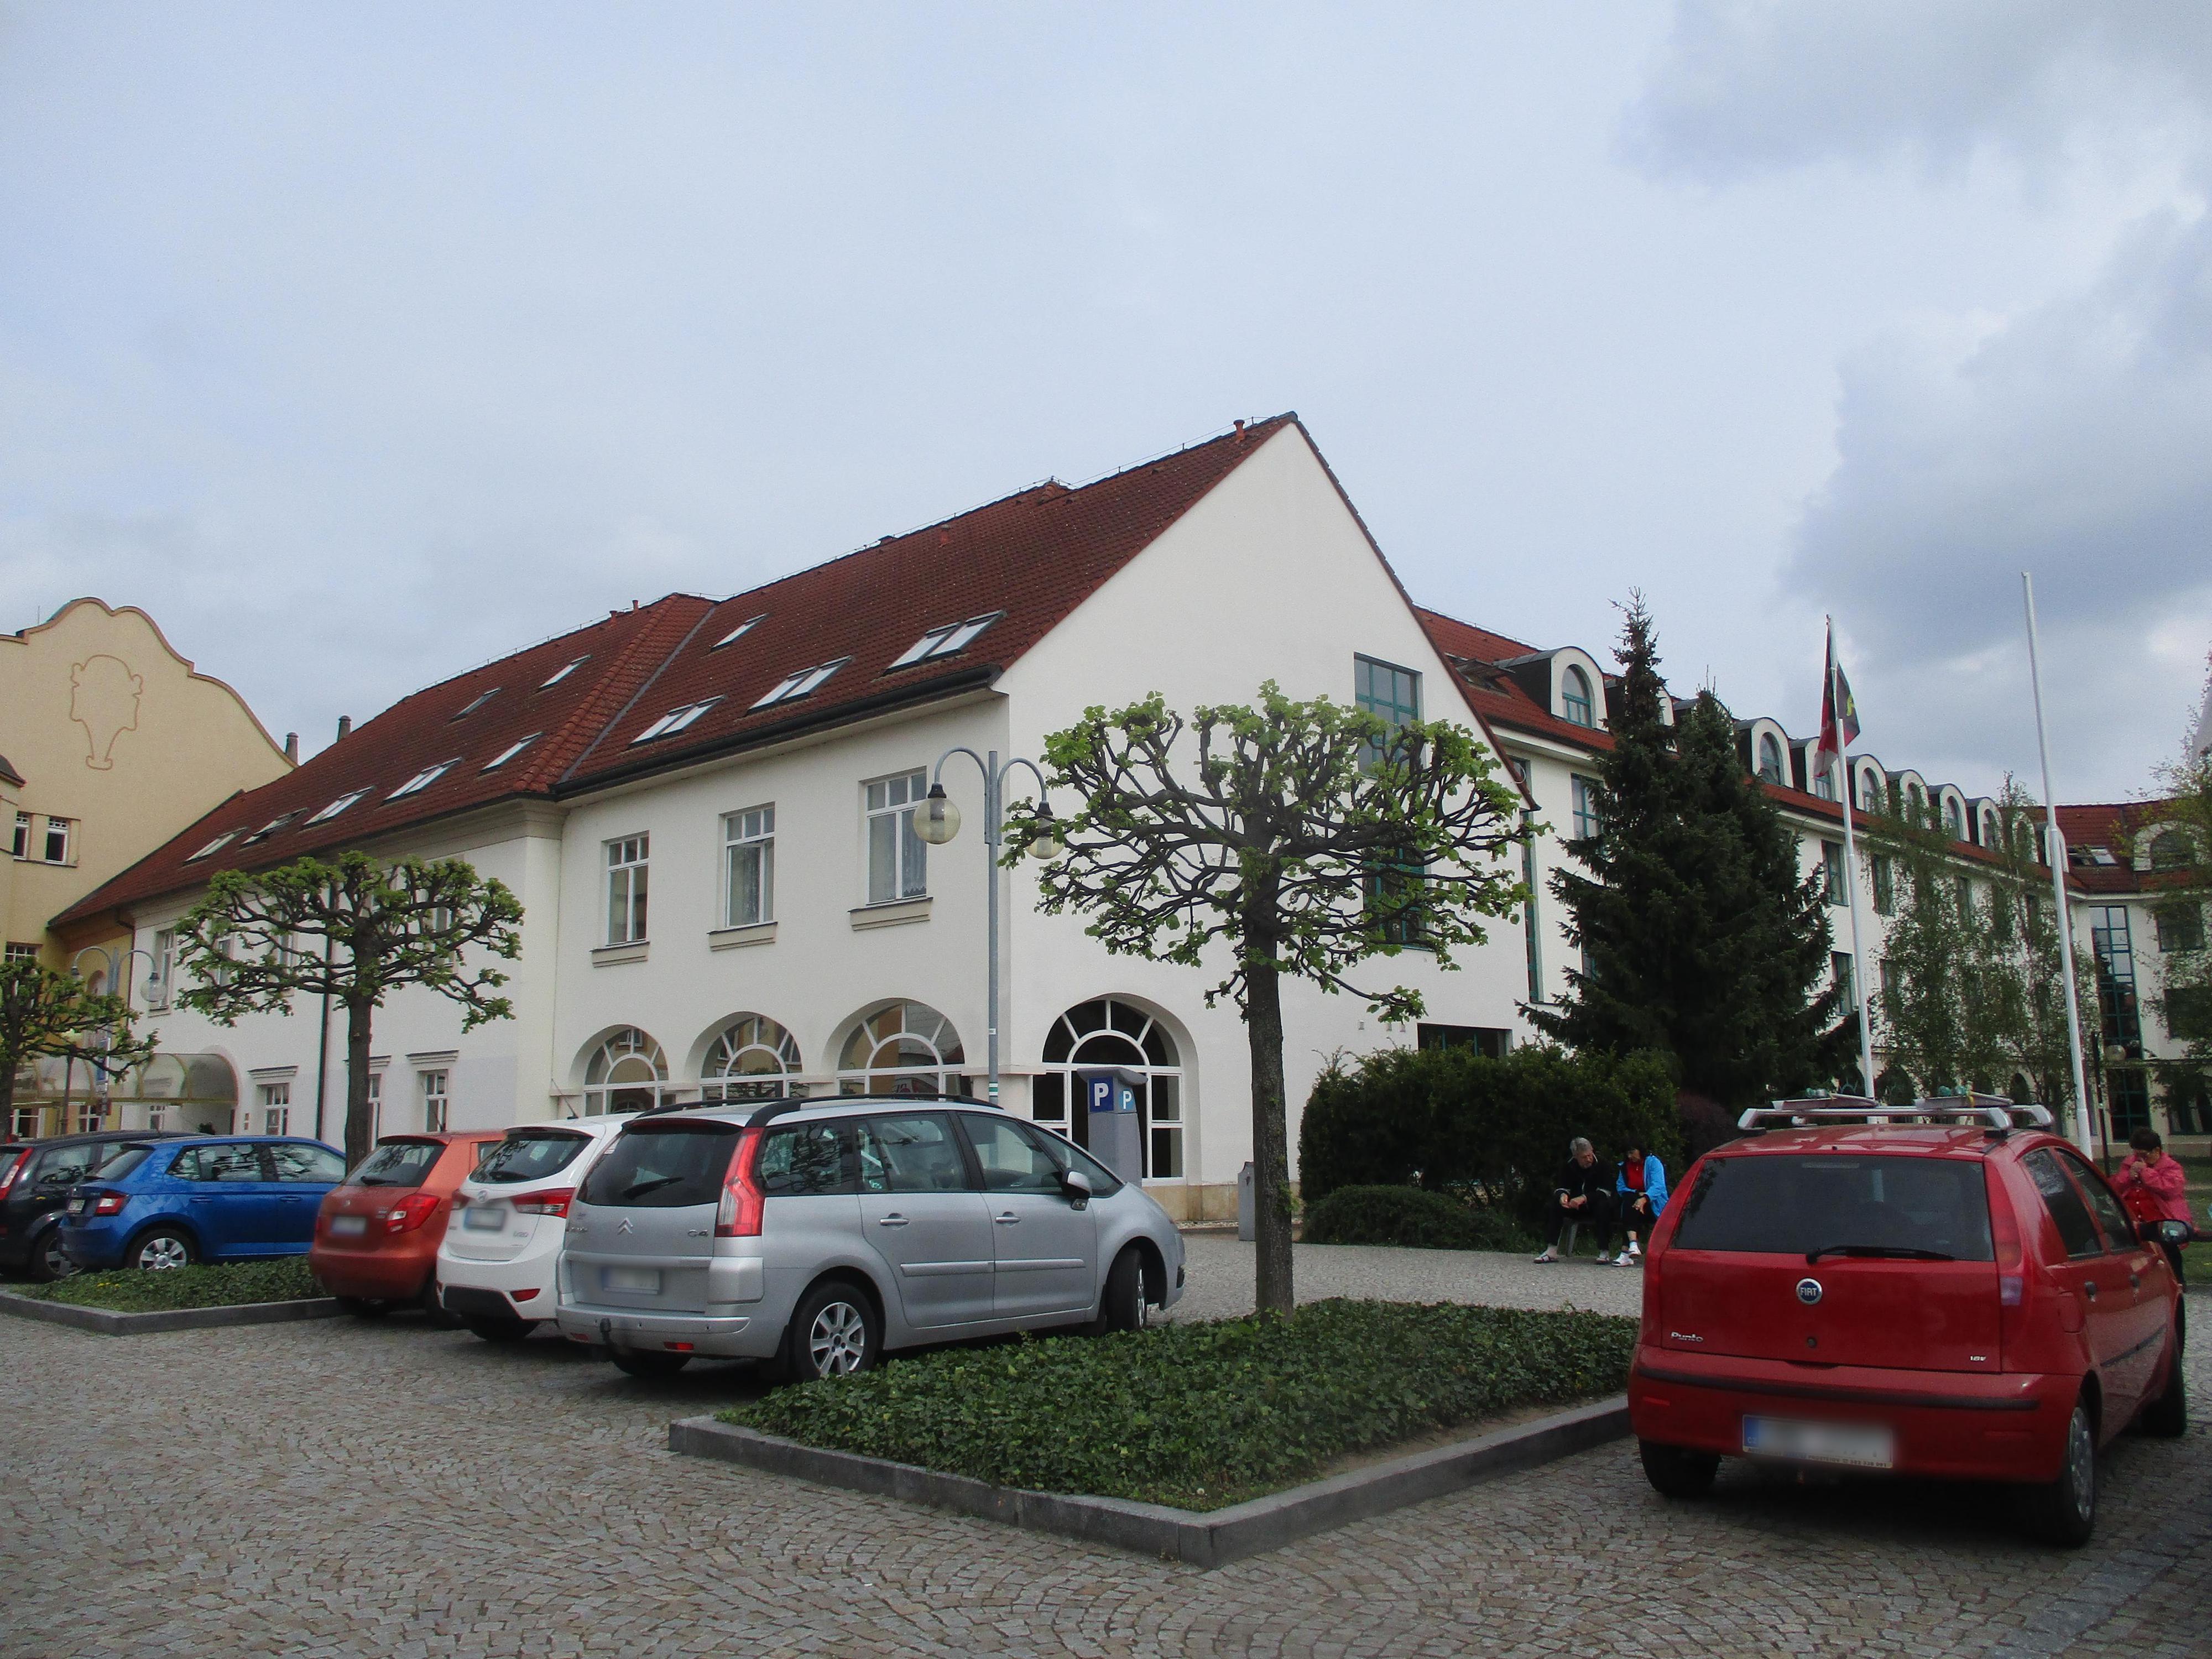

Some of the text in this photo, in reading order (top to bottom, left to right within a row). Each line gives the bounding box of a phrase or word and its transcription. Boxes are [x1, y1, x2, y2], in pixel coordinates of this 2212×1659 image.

[1094, 1083, 1109, 1107] P
[1123, 1091, 1132, 1109] P
[1800, 1287, 1817, 1297] FIAT
[1671, 1331, 1704, 1343] Punto
